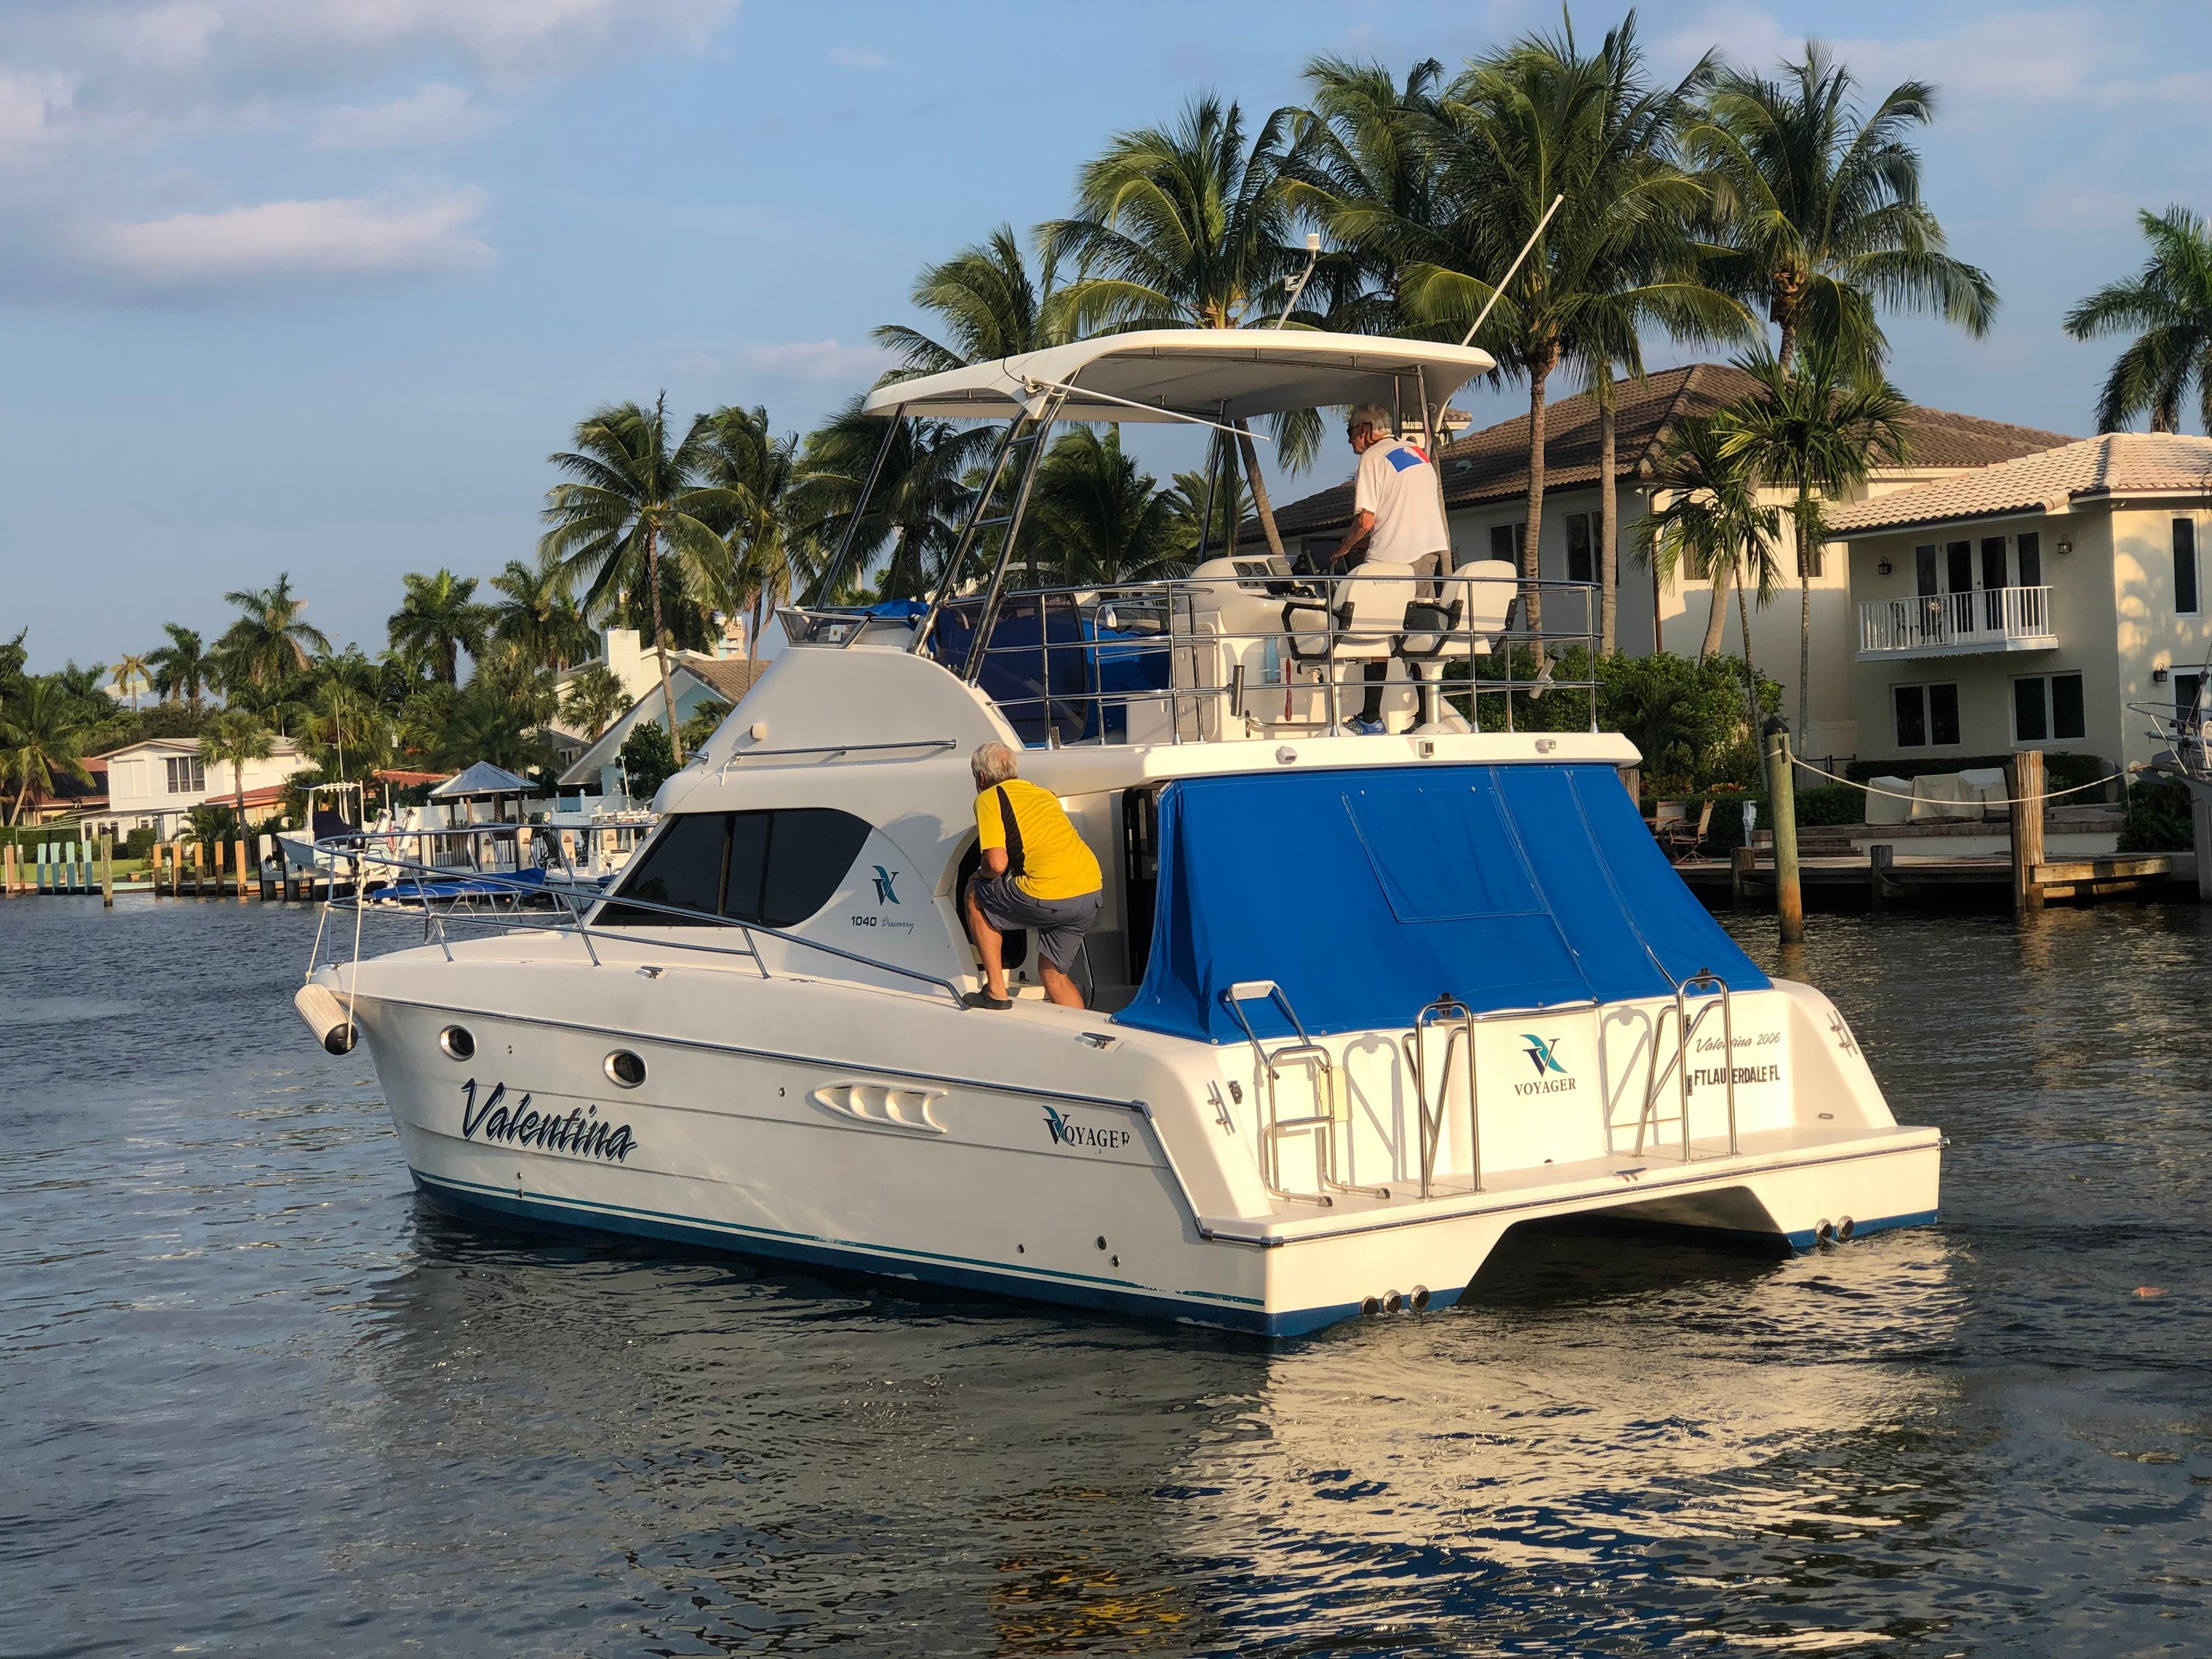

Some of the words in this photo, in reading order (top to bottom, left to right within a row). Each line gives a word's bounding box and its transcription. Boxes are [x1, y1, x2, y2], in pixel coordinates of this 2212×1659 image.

[851, 916, 877, 927] 1040
[881, 916, 914, 935] Discovery
[1757, 1032, 1780, 1046] 2006
[1707, 1066, 1767, 1085] LAUERDALE
[1769, 1064, 1780, 1081] FL
[1514, 1077, 1576, 1096] VOYAGER
[461, 1077, 637, 1163] Valentina
[1042, 1113, 1130, 1148] VOYAGER
